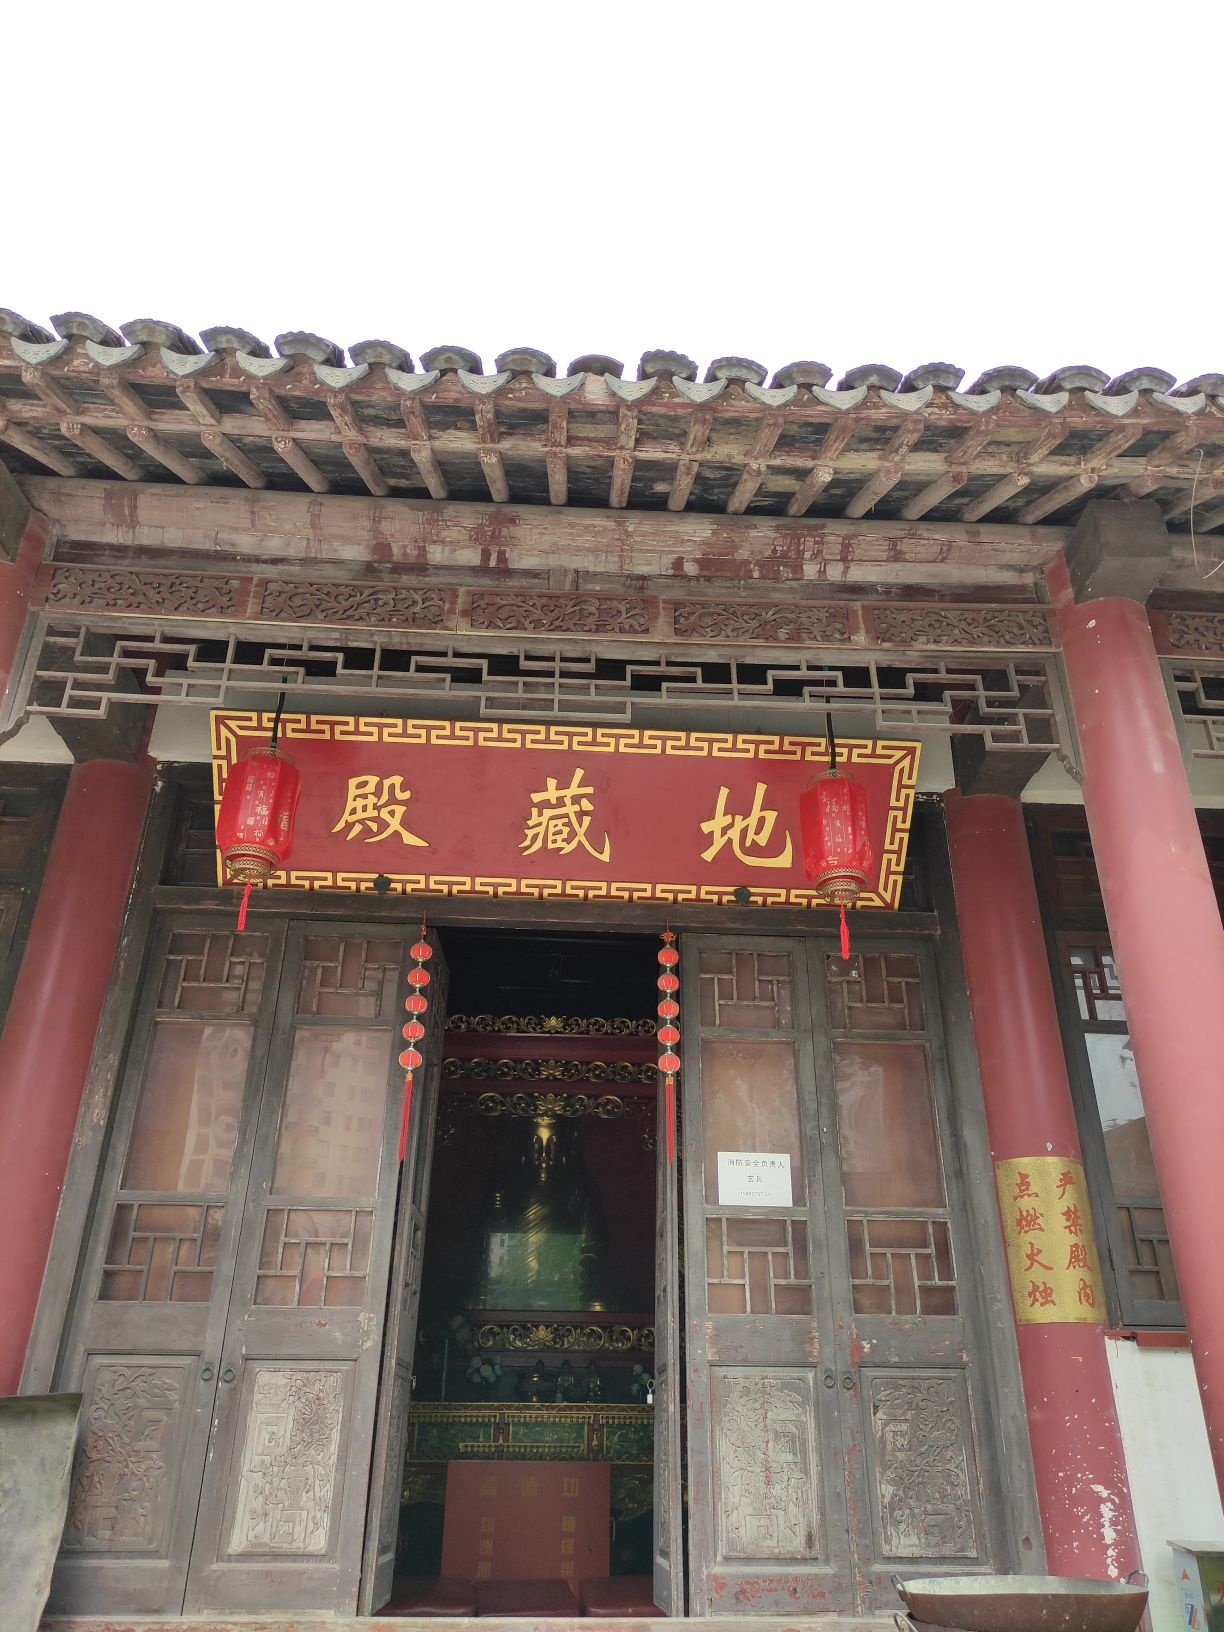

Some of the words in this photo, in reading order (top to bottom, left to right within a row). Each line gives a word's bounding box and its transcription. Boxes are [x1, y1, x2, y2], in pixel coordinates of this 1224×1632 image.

[331, 767, 793, 868] 地藏殿
[1013, 1171, 1057, 1308] 点燃火烛
[1056, 1171, 1096, 1309] 严禁殿内
